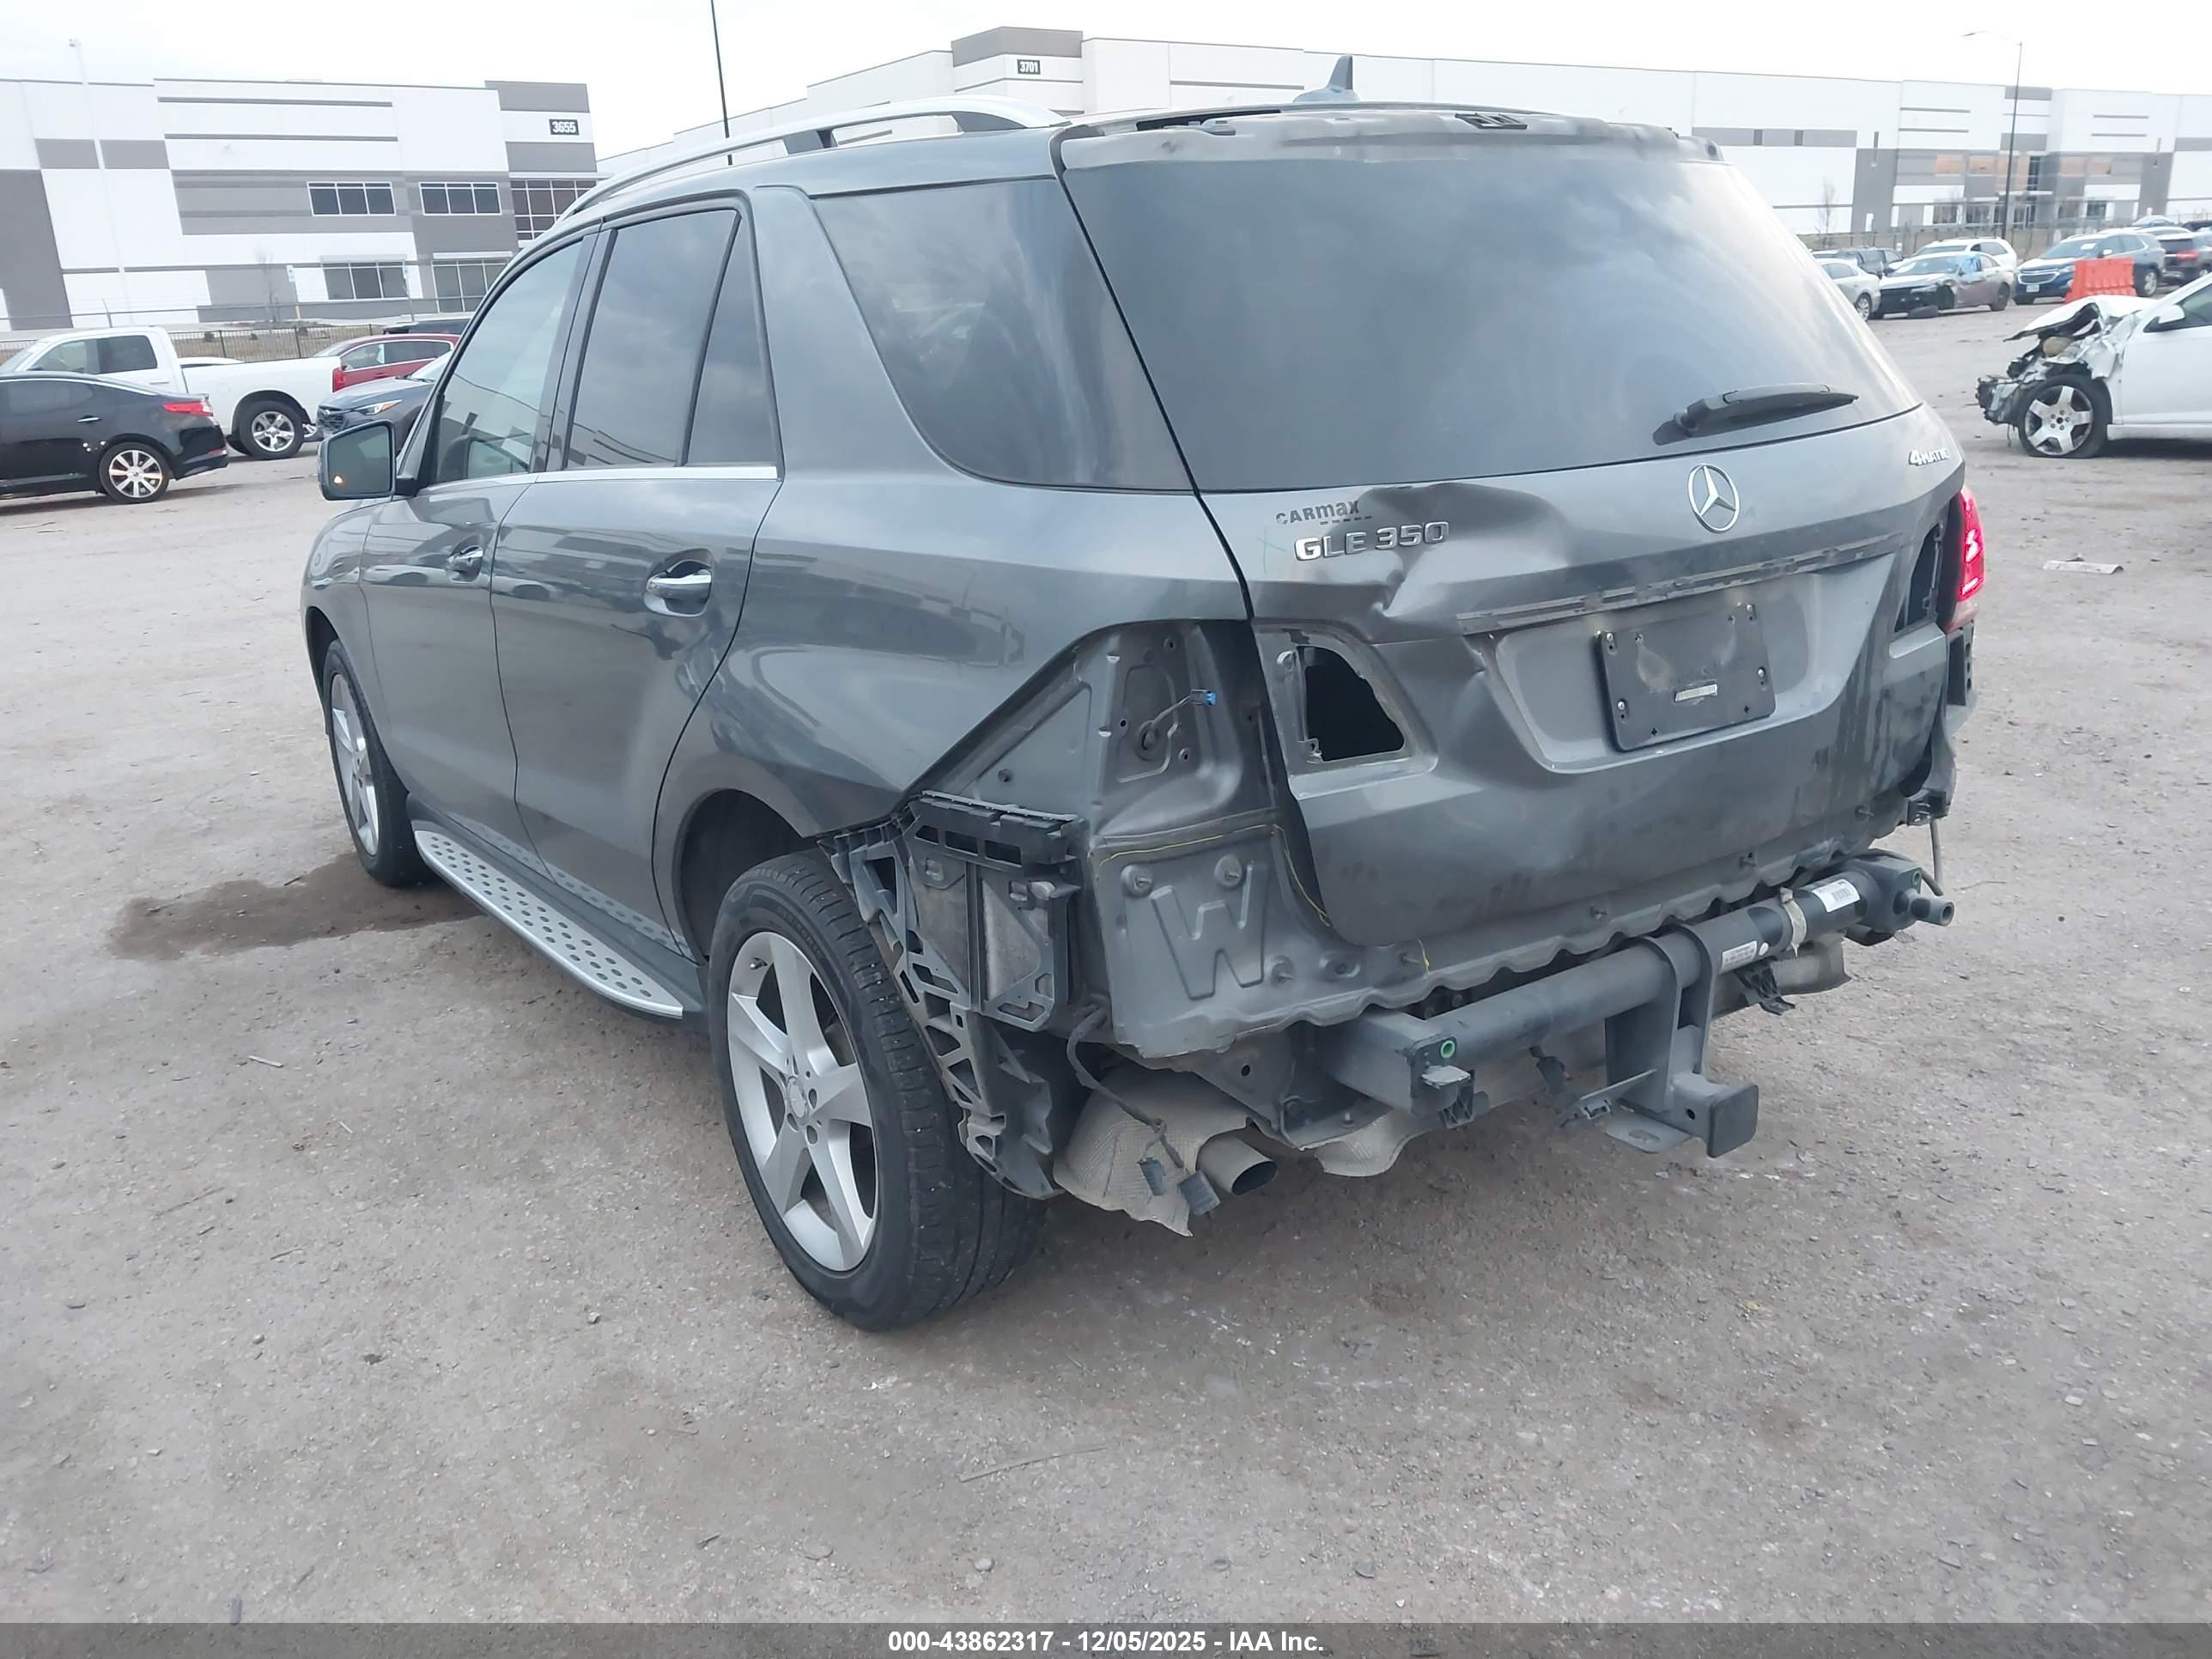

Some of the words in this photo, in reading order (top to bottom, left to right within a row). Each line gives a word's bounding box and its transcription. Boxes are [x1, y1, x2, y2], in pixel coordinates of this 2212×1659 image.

[1019, 61, 1039, 73] 3701
[551, 121, 577, 133] 3655
[1909, 448, 1949, 465] 4MATIC
[1294, 531, 1368, 561] GLE
[1375, 521, 1449, 550] 350
